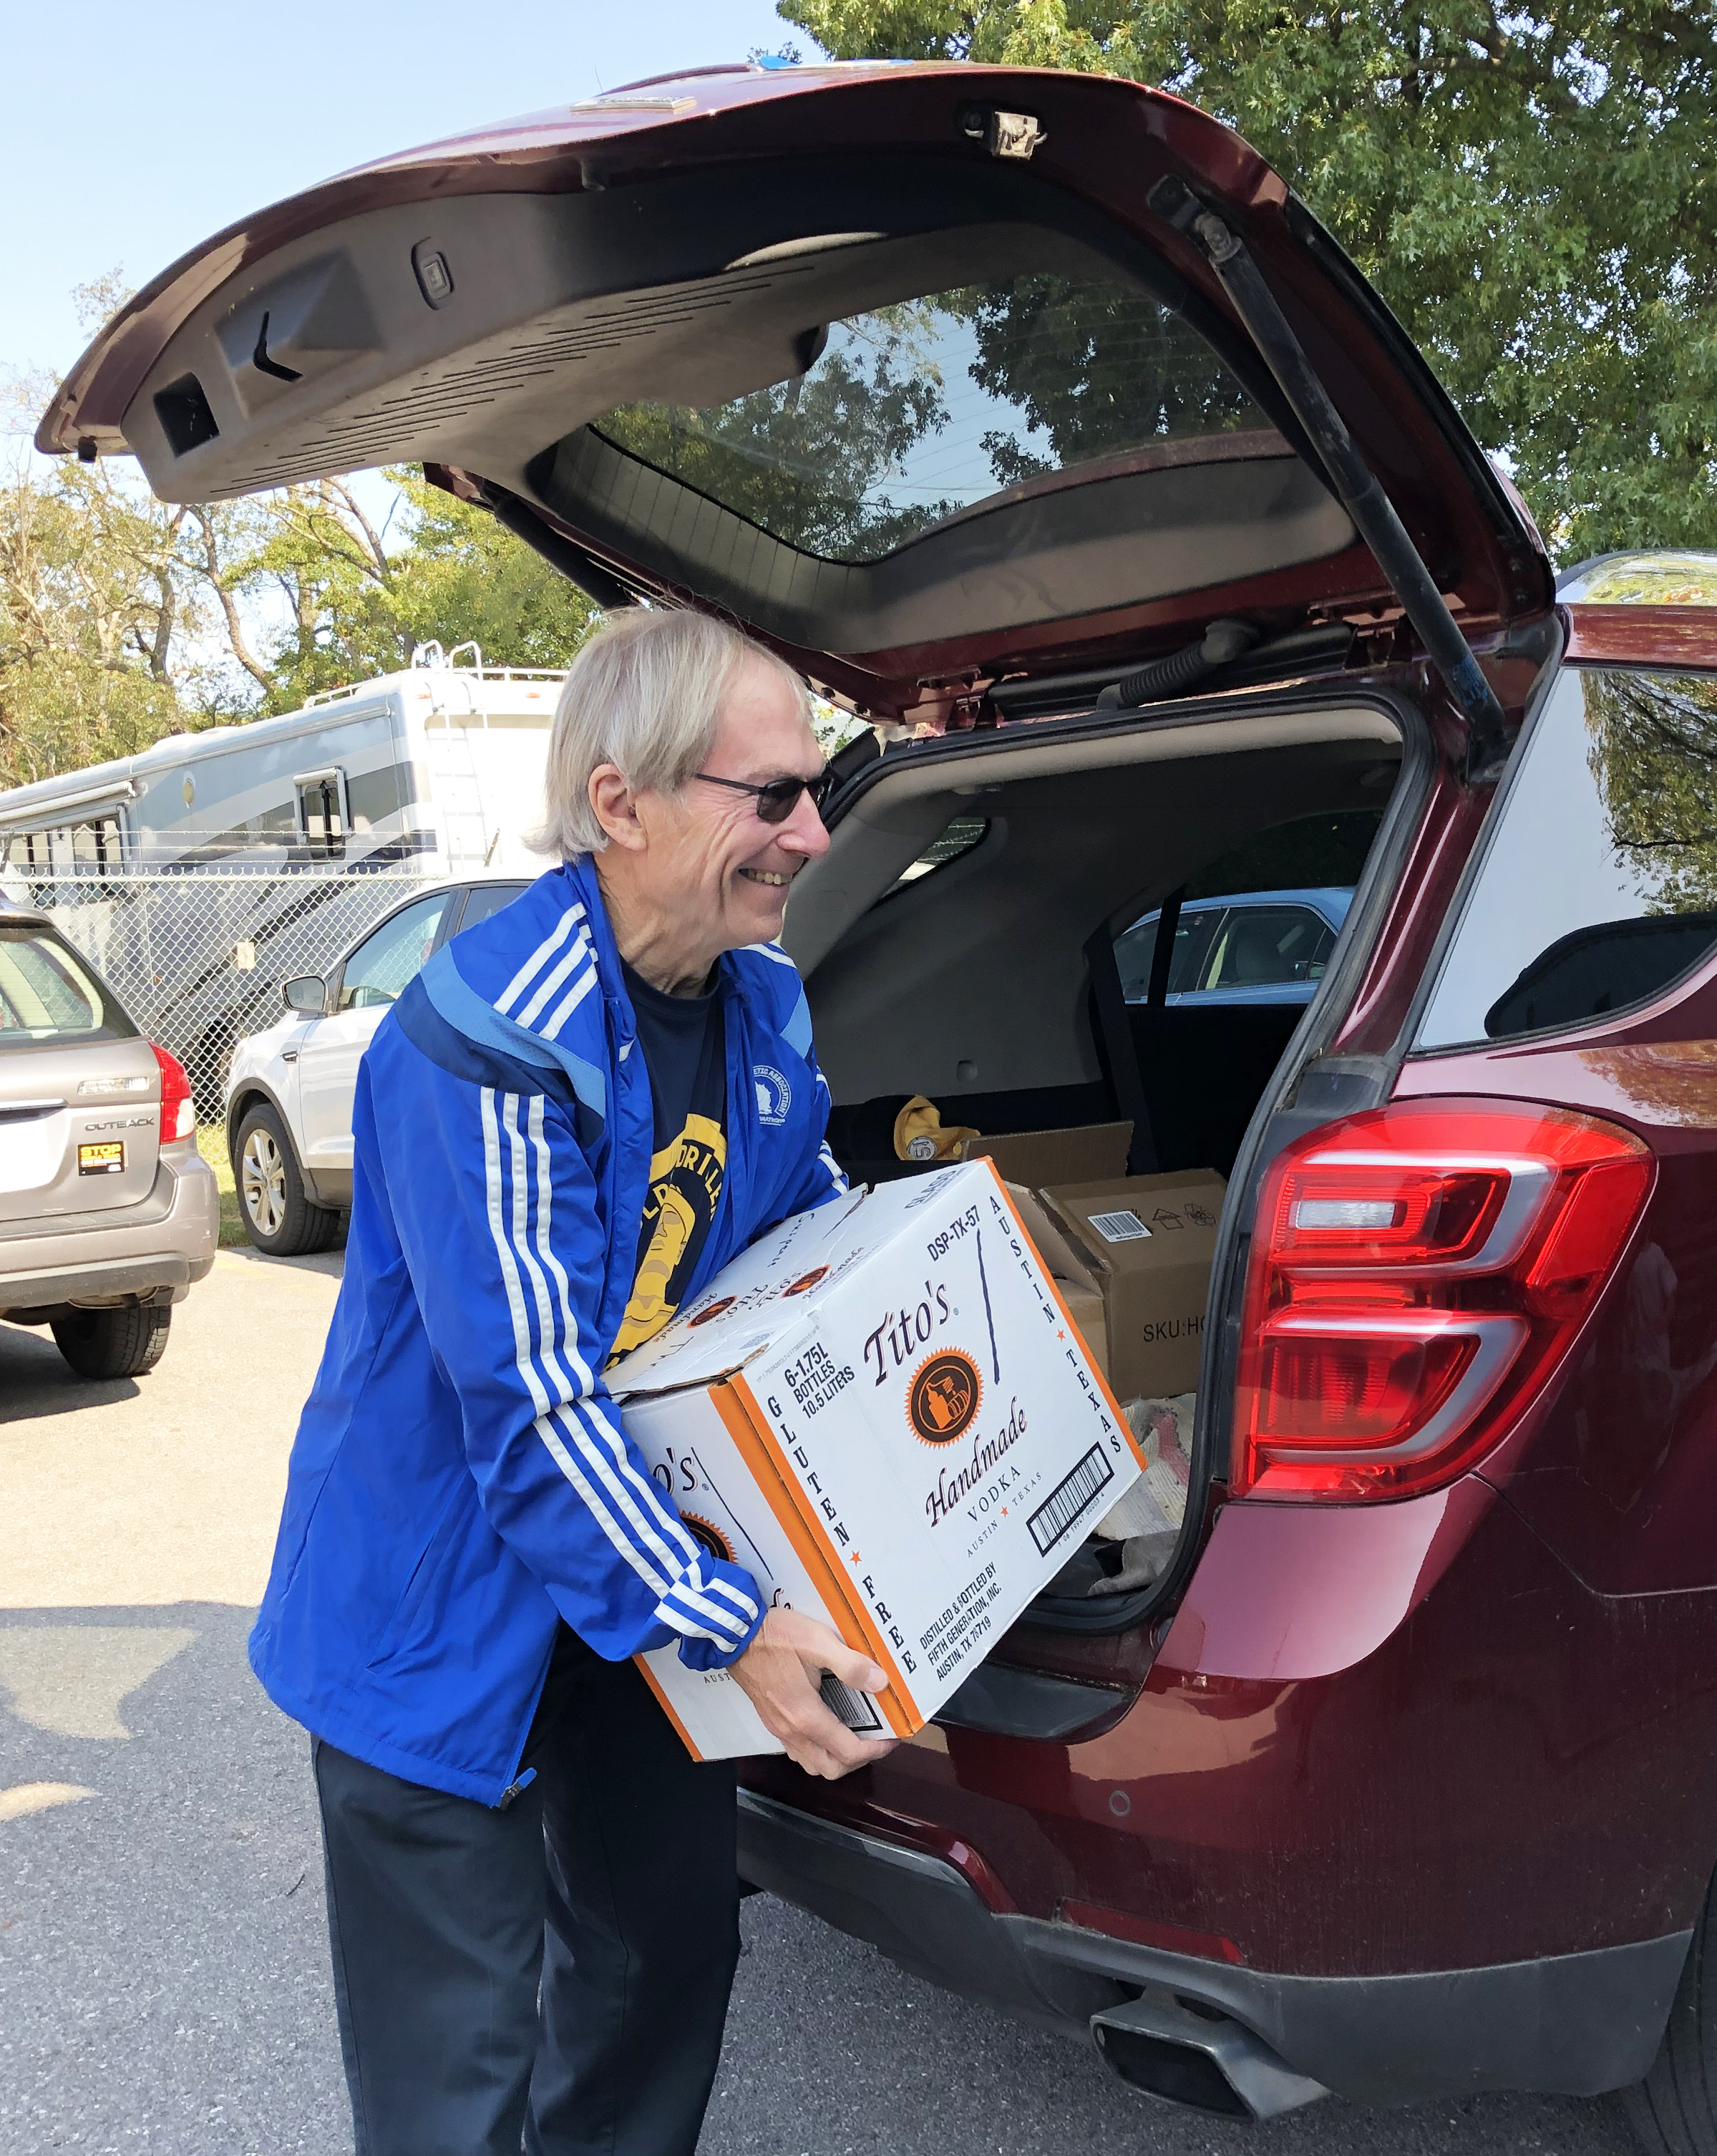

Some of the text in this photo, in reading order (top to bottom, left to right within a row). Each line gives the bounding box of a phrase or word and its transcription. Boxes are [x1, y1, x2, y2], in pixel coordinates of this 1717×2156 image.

[768, 1070, 789, 1114] ASSOCIATION
[80, 1143, 122, 1156] STOP
[84, 1117, 155, 1131] OUTBACK
[904, 1170, 957, 1209] GLASS
[927, 1204, 980, 1262] DSP-TX-57
[864, 1279, 950, 1387] Tito's
[989, 1195, 1122, 1454] AUSTIN TEXAS
[784, 1341, 829, 1388] 6-1.75L
[793, 1359, 835, 1404] BOTTLES
[802, 1366, 855, 1419] 10.5 LITERS
[653, 1447, 699, 1495] o's
[925, 1395, 1028, 1528] Handmade
[966, 1465, 1021, 1523] VODKA
[967, 1472, 1042, 1558] AUSTIN TEXAS
[767, 1395, 851, 1547] GLUTEN
[862, 1575, 918, 1674] FREE
[919, 1561, 997, 1650] DISTILLED & BOTTLED BY
[928, 1582, 1002, 1666] FIFTH GENERATION, INC.
[704, 1673, 731, 1684] AUST
[936, 1648, 965, 1682] AUSTIN,
[960, 1636, 973, 1653] TX
